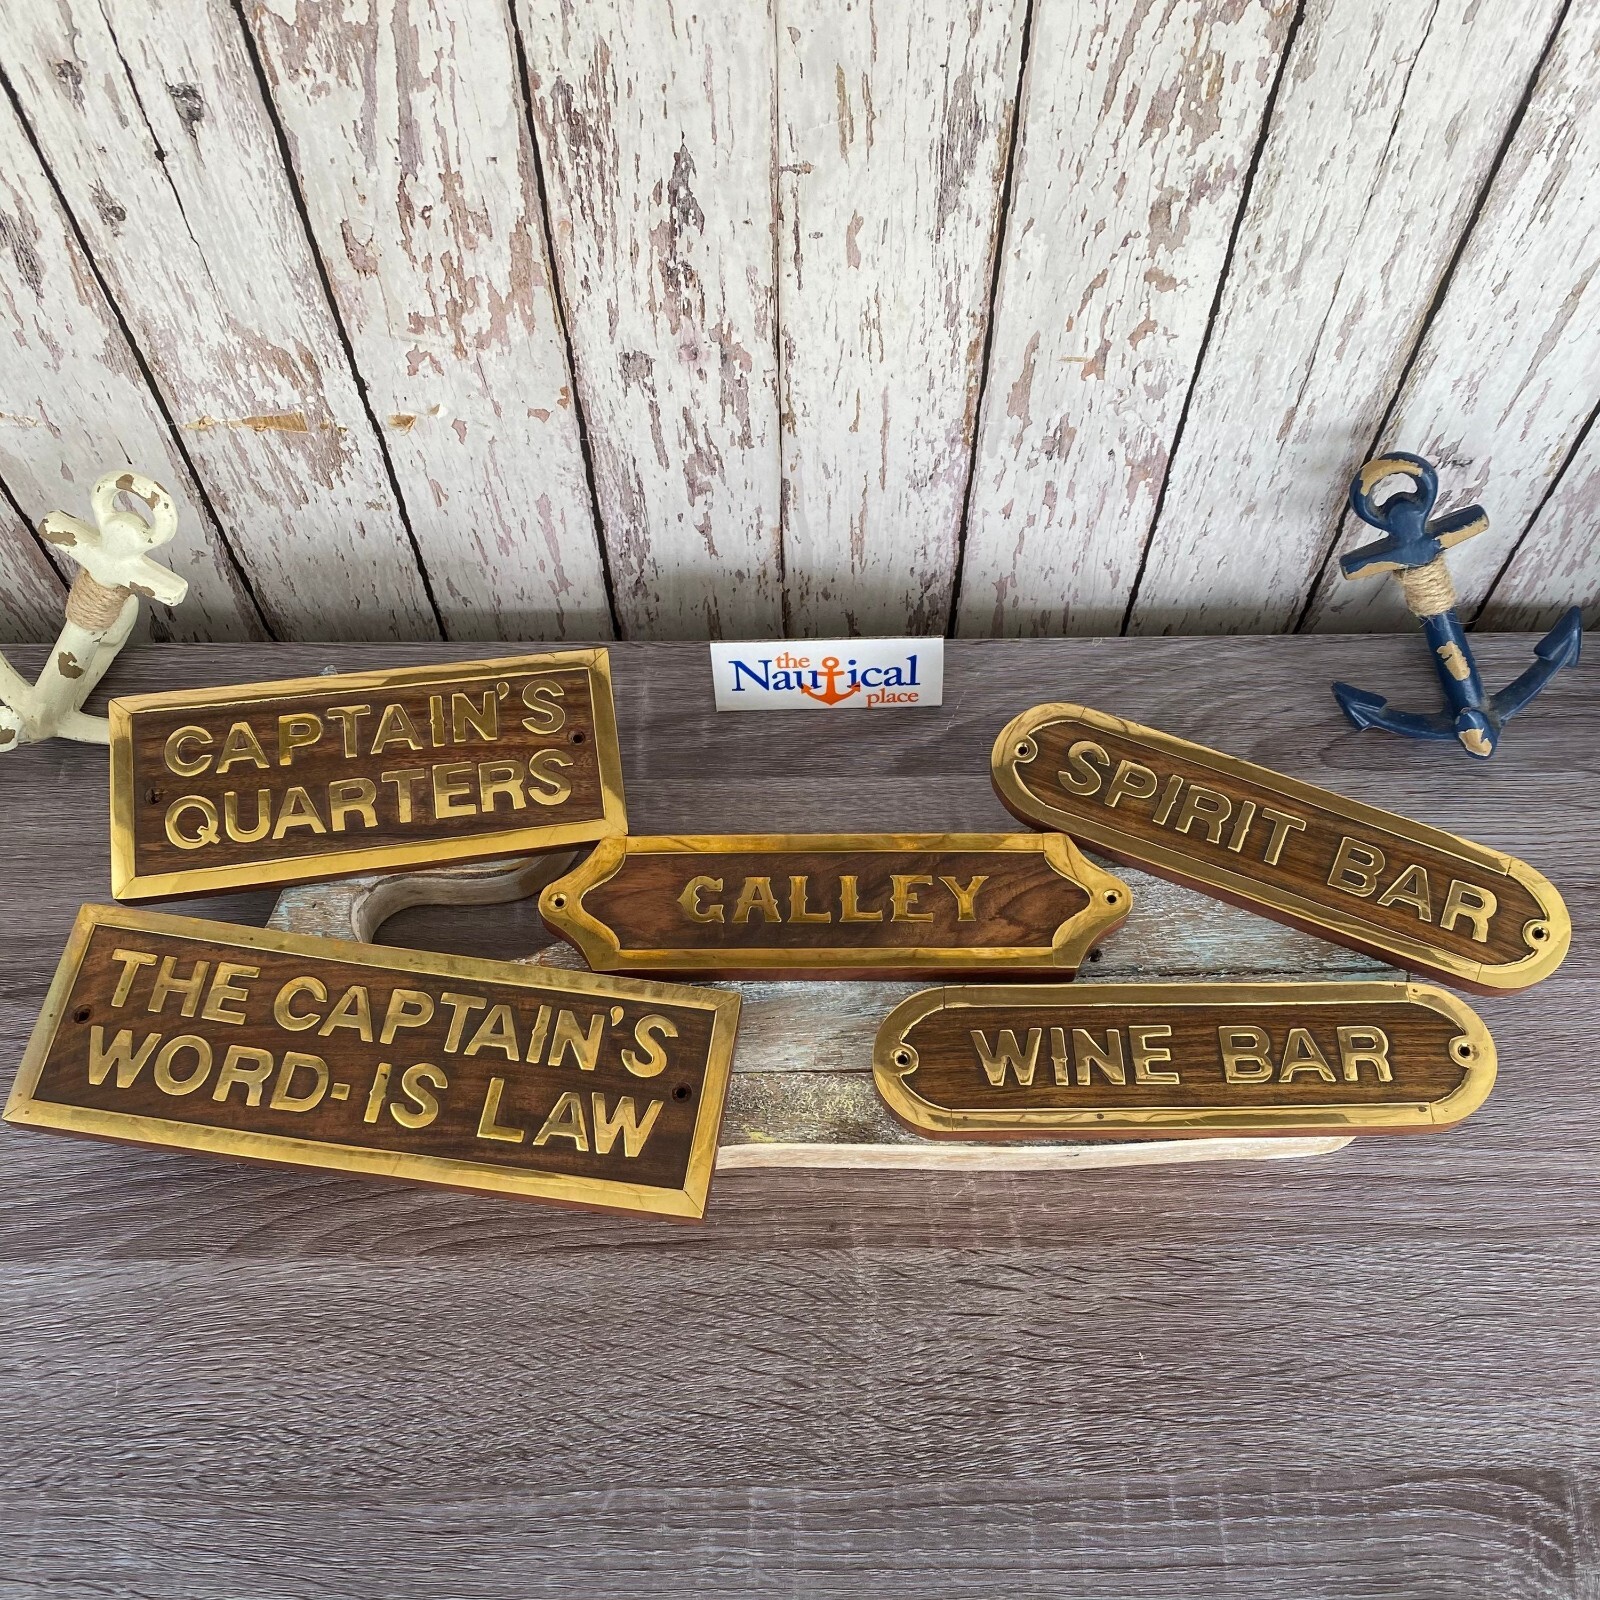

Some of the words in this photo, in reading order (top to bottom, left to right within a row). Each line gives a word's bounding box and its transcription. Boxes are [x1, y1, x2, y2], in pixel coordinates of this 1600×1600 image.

[775, 651, 810, 669] the
[866, 688, 919, 709] place
[164, 679, 567, 777] CAPTAIN'S
[164, 749, 573, 850] QUARTERS
[1057, 739, 1306, 866] SPIRIT
[1326, 836, 1498, 943] BAR
[676, 874, 990, 924] GALLEY
[111, 948, 262, 1025] THE
[273, 975, 679, 1079] CAPTAIN'S
[970, 1024, 1180, 1087] WINE
[1218, 1024, 1394, 1084] BAR
[476, 1077, 665, 1158] LAW
